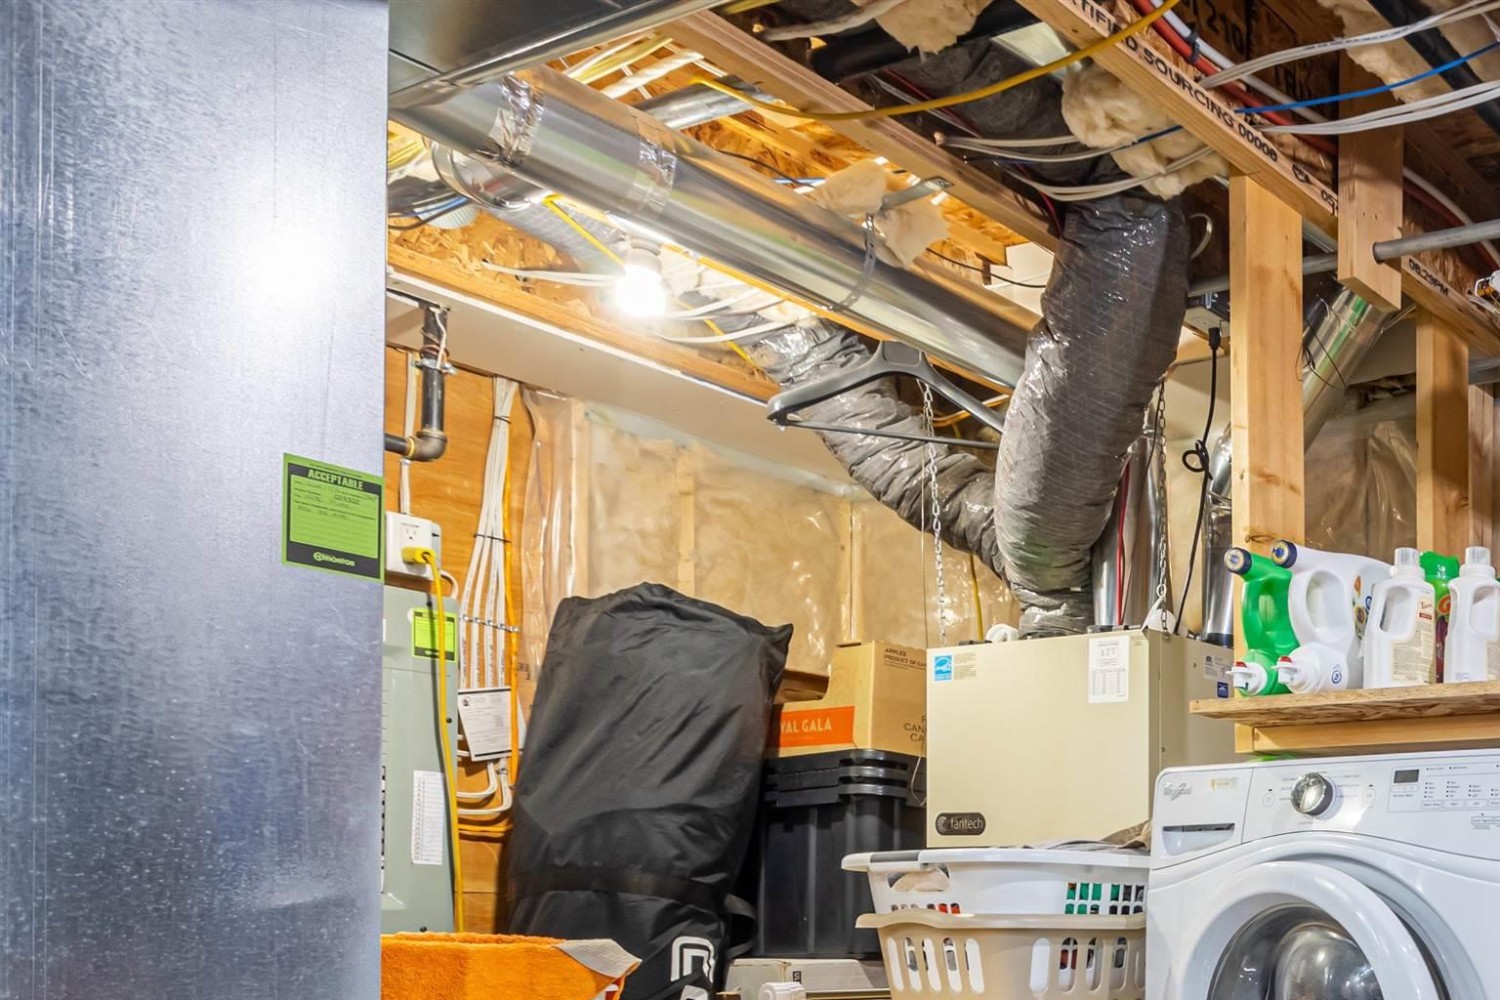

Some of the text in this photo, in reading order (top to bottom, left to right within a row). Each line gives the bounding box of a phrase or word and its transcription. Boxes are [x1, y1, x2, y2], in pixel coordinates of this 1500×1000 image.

[1143, 48, 1234, 129] SOURCING
[308, 468, 364, 490] ACCEPTABLE
[884, 654, 909, 664] PRODUCT
[885, 648, 906, 657] APPLES
[802, 718, 832, 732] GALA
[951, 817, 983, 829] fantech
